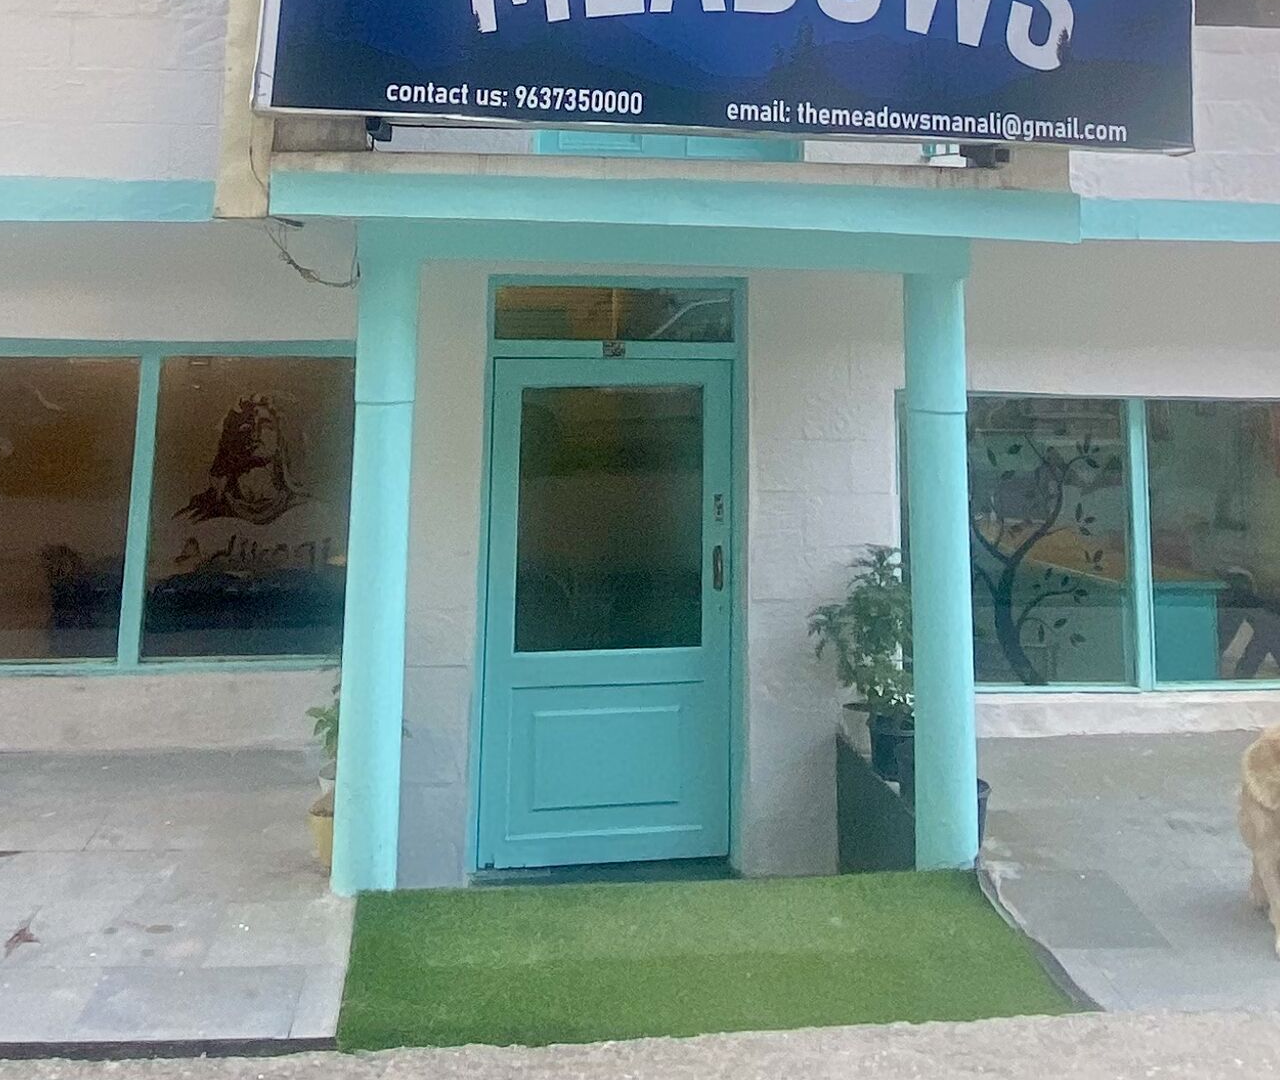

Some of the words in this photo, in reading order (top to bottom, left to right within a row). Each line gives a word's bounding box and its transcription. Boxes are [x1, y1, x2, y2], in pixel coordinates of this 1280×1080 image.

[386, 82, 469, 105] contact
[476, 87, 508, 108] us:
[515, 85, 643, 115] 9637350000
[726, 100, 791, 123] email:
[797, 101, 1128, 142] themeadowsmanali@gmail.com
